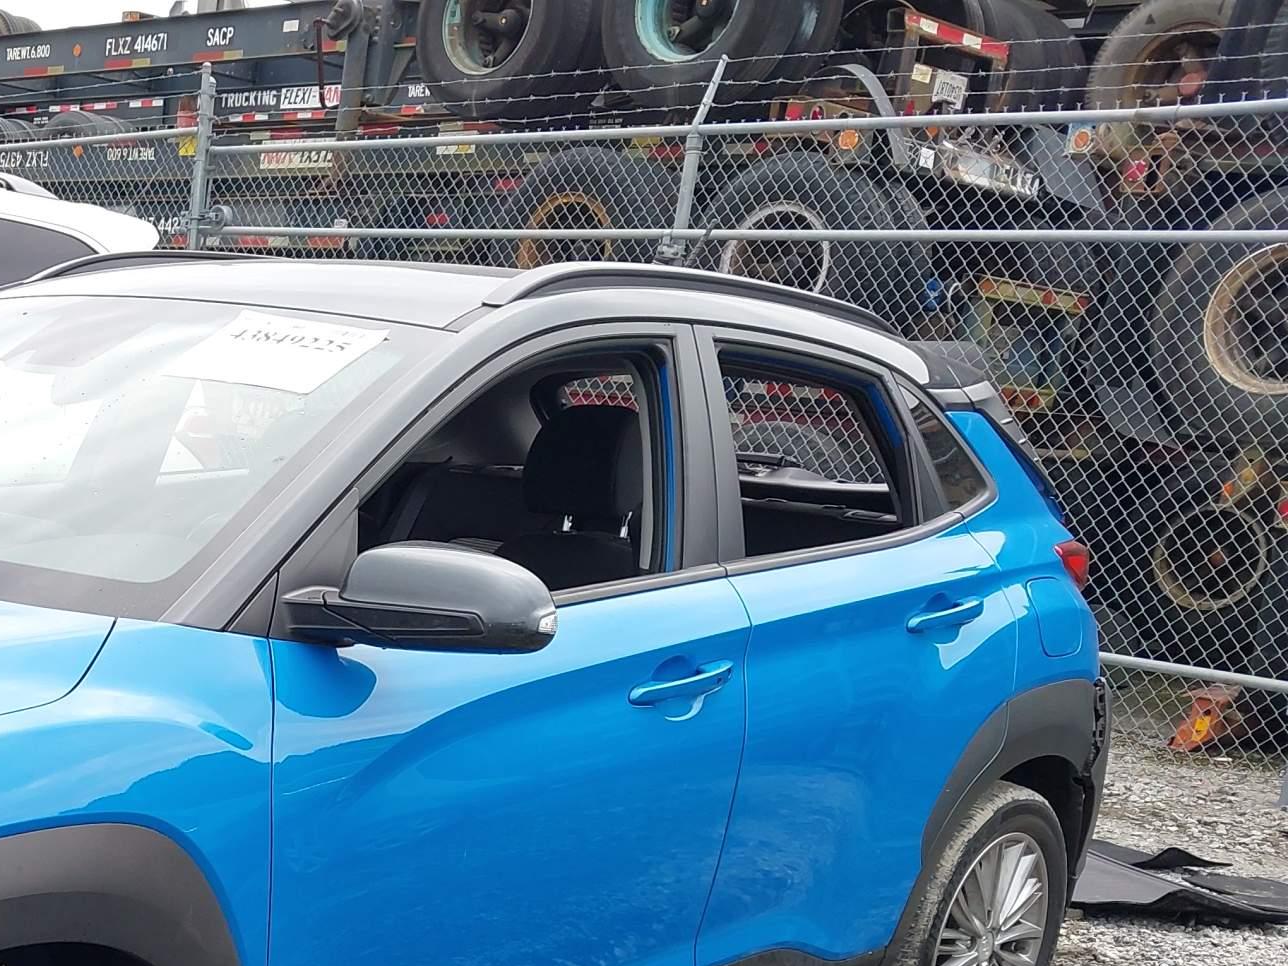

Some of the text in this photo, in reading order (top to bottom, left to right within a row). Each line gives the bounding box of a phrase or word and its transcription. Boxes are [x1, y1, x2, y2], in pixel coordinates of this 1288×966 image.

[105, 33, 168, 56] FLXZ 414671
[206, 27, 234, 47] SACP
[221, 91, 277, 108] TRUCKING
